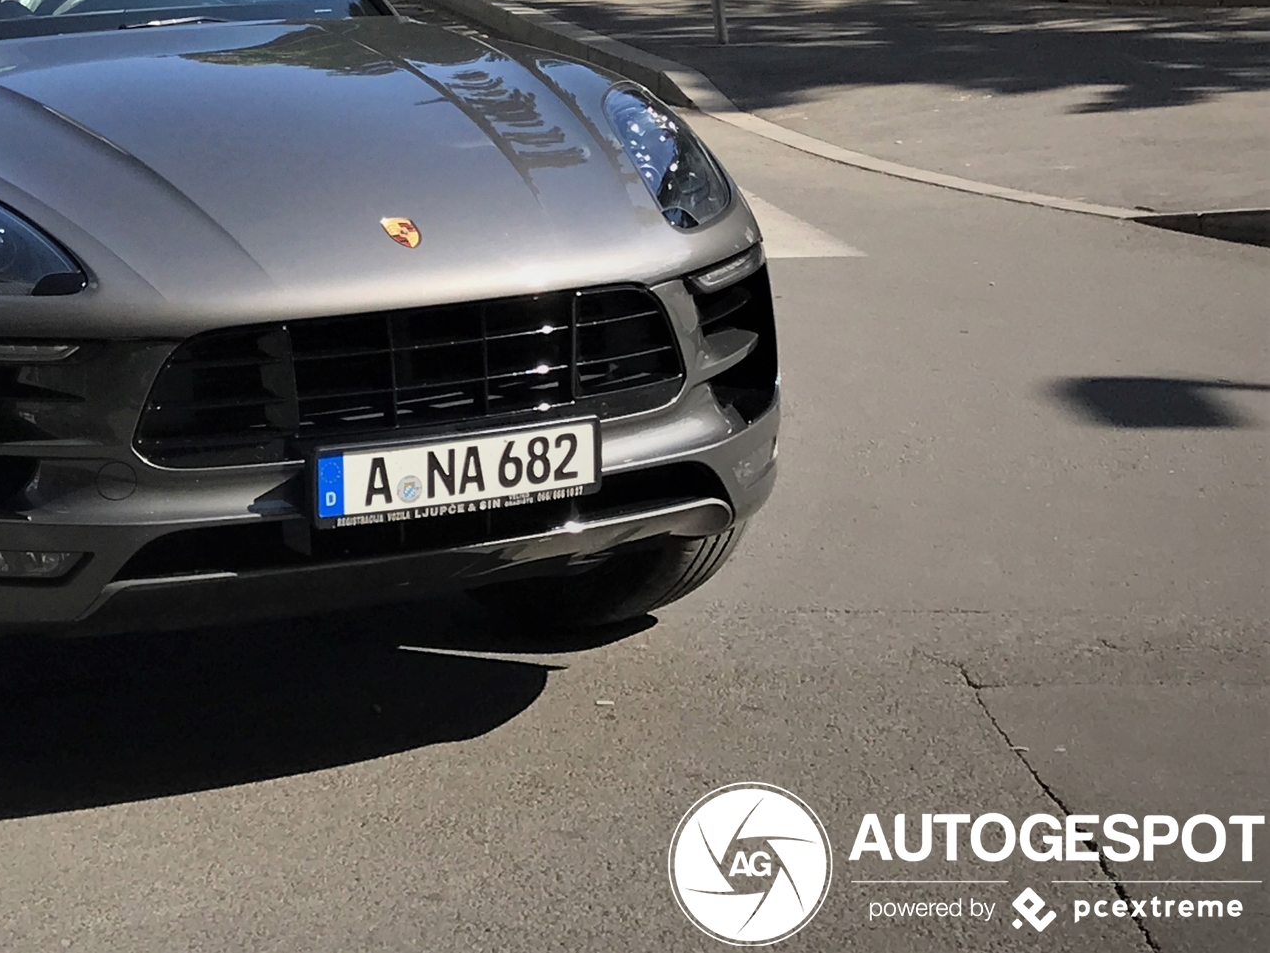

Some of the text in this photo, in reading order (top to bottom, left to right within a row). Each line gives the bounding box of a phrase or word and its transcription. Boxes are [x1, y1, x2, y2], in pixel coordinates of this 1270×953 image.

[365, 433, 578, 506] A NA 682
[326, 491, 336, 507] D
[387, 511, 410, 522] VOZILA
[479, 499, 501, 511] SIN
